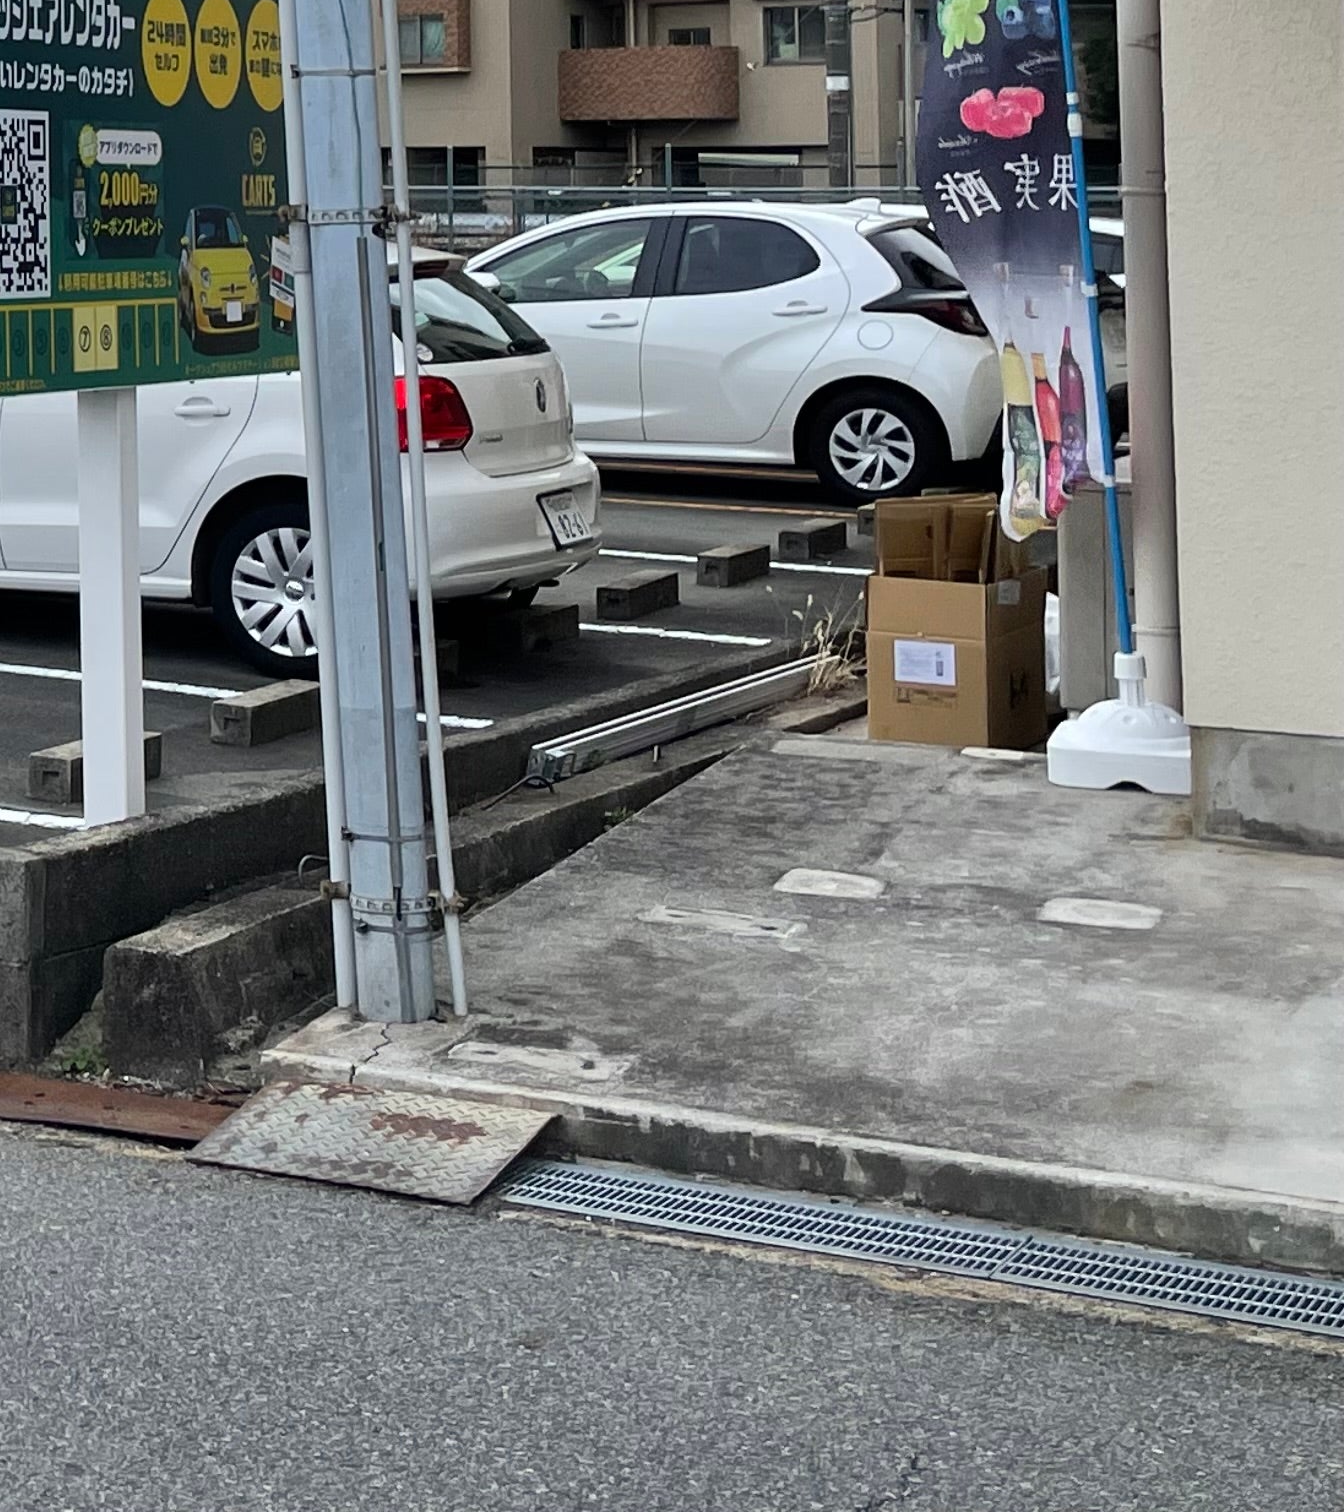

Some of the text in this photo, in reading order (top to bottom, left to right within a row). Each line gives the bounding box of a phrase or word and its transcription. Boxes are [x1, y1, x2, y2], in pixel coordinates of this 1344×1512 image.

[147, 20, 187, 47] 24時間
[154, 52, 180, 72] セルフ
[99, 140, 158, 156] アプリダウンロードで
[99, 170, 159, 210] 2,000円分
[242, 174, 276, 207] CARTS
[92, 216, 164, 238] クーポンプレゼント
